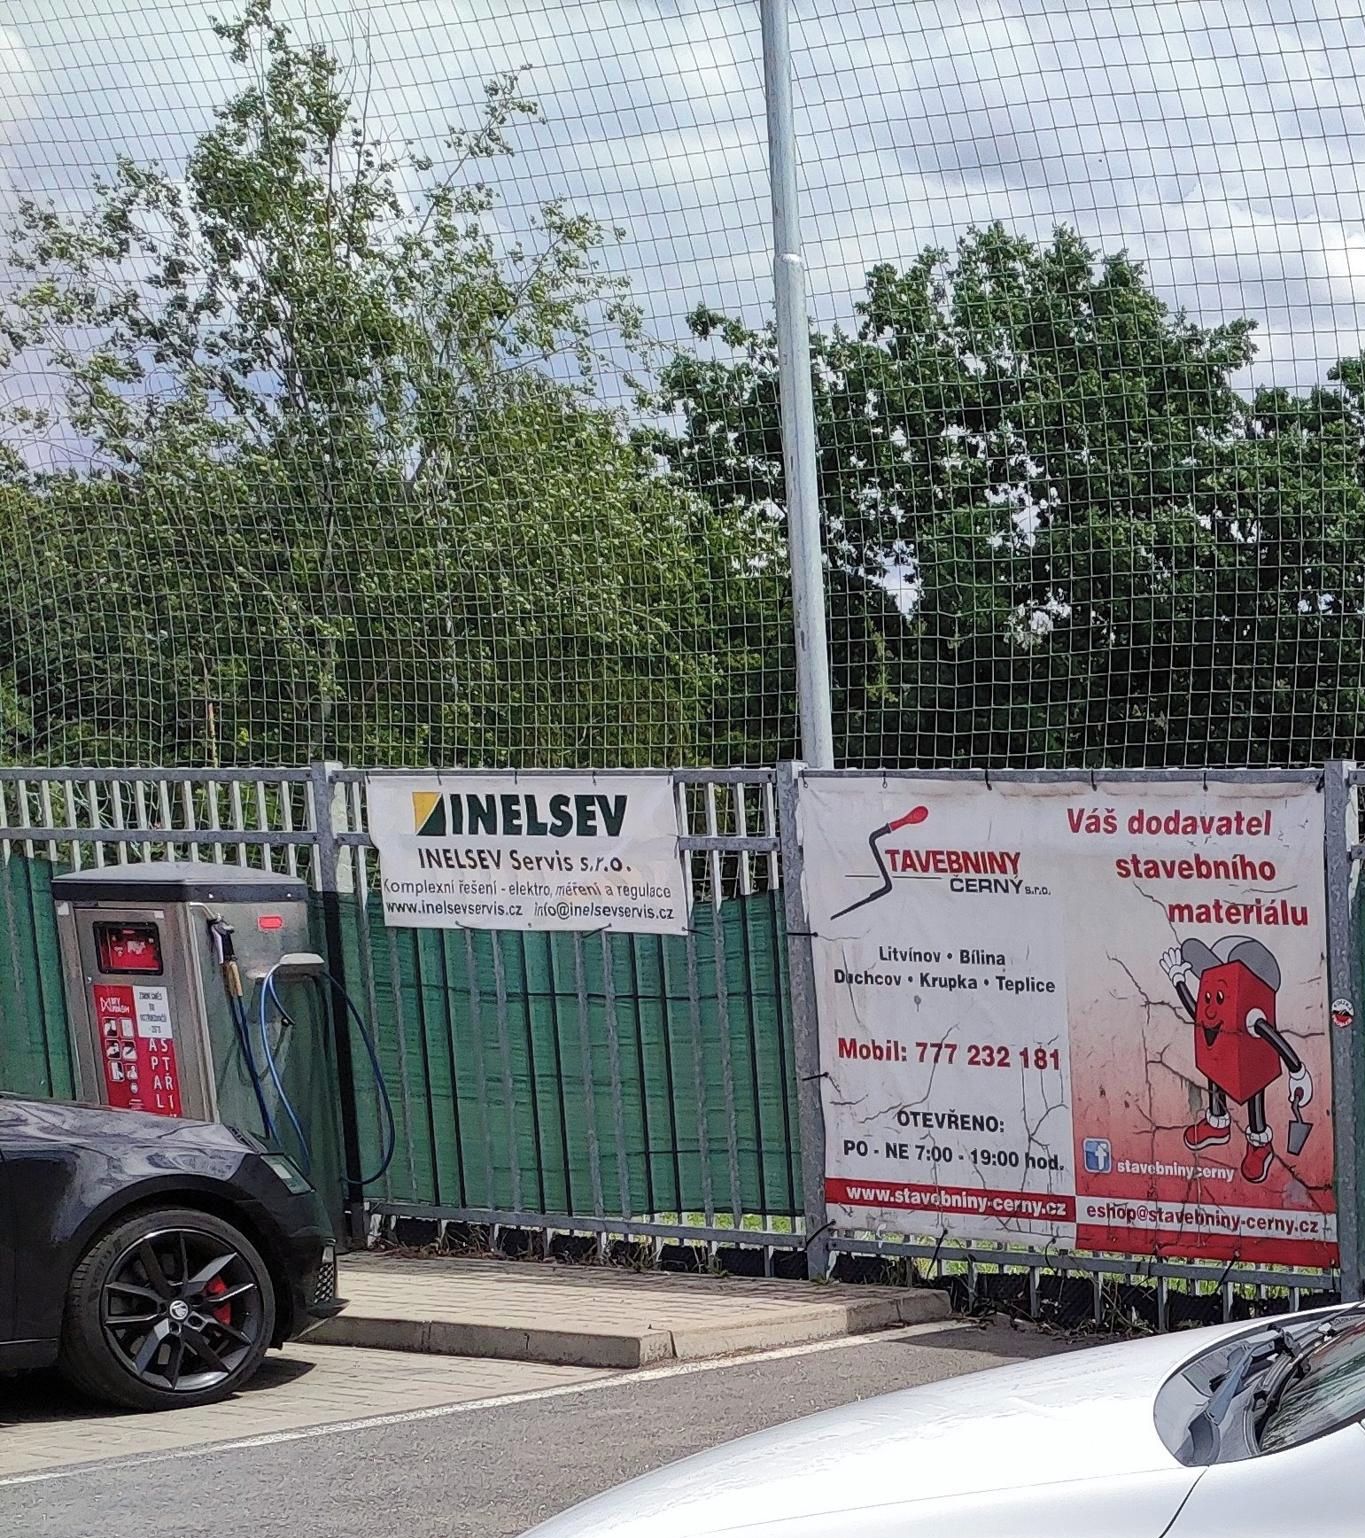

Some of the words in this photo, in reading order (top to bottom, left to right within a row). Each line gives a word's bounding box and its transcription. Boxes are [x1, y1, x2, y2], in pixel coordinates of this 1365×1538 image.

[450, 793, 628, 838] INELSEV
[1067, 807, 1118, 835] Váš
[1128, 808, 1272, 836] dodavatel
[417, 847, 502, 869] INELSEV
[509, 849, 574, 872] Servis
[580, 856, 632, 873] s.r.o.
[1115, 853, 1276, 881] stavebního
[384, 878, 455, 897] Komplexní
[459, 879, 498, 895] řešení
[509, 881, 553, 898] elektro,
[555, 881, 601, 897] měření
[605, 884, 614, 896] a
[618, 882, 672, 900] regulace
[950, 875, 1023, 895] ČERNÝ
[1025, 886, 1052, 896] s.r.o.
[385, 899, 524, 917] www.inelsevservis.cz
[534, 901, 675, 921] info@inelsevservis.cz
[1167, 899, 1309, 926] materiálu
[879, 945, 942, 963] Litvínov
[959, 948, 1006, 966] Bílina
[833, 968, 902, 987] Duchcov
[919, 972, 978, 990] Krupka
[995, 975, 1056, 995] Teplice
[837, 1037, 908, 1063] Mobil:
[915, 1041, 958, 1065] 777
[966, 1045, 1011, 1069] 232
[1018, 1046, 1061, 1071] 181
[896, 1109, 1005, 1133] OTEVŘENO:
[843, 1140, 869, 1157] PO
[885, 1142, 910, 1161] NE
[915, 1145, 953, 1164] 7:00
[970, 1149, 1020, 1168] 19:00
[1024, 1152, 1066, 1171] hod.
[846, 1186, 1067, 1217] www.stavebniny-cerny.cz
[1086, 1204, 1319, 1235] eshop@stavebniny-cerny.cz
